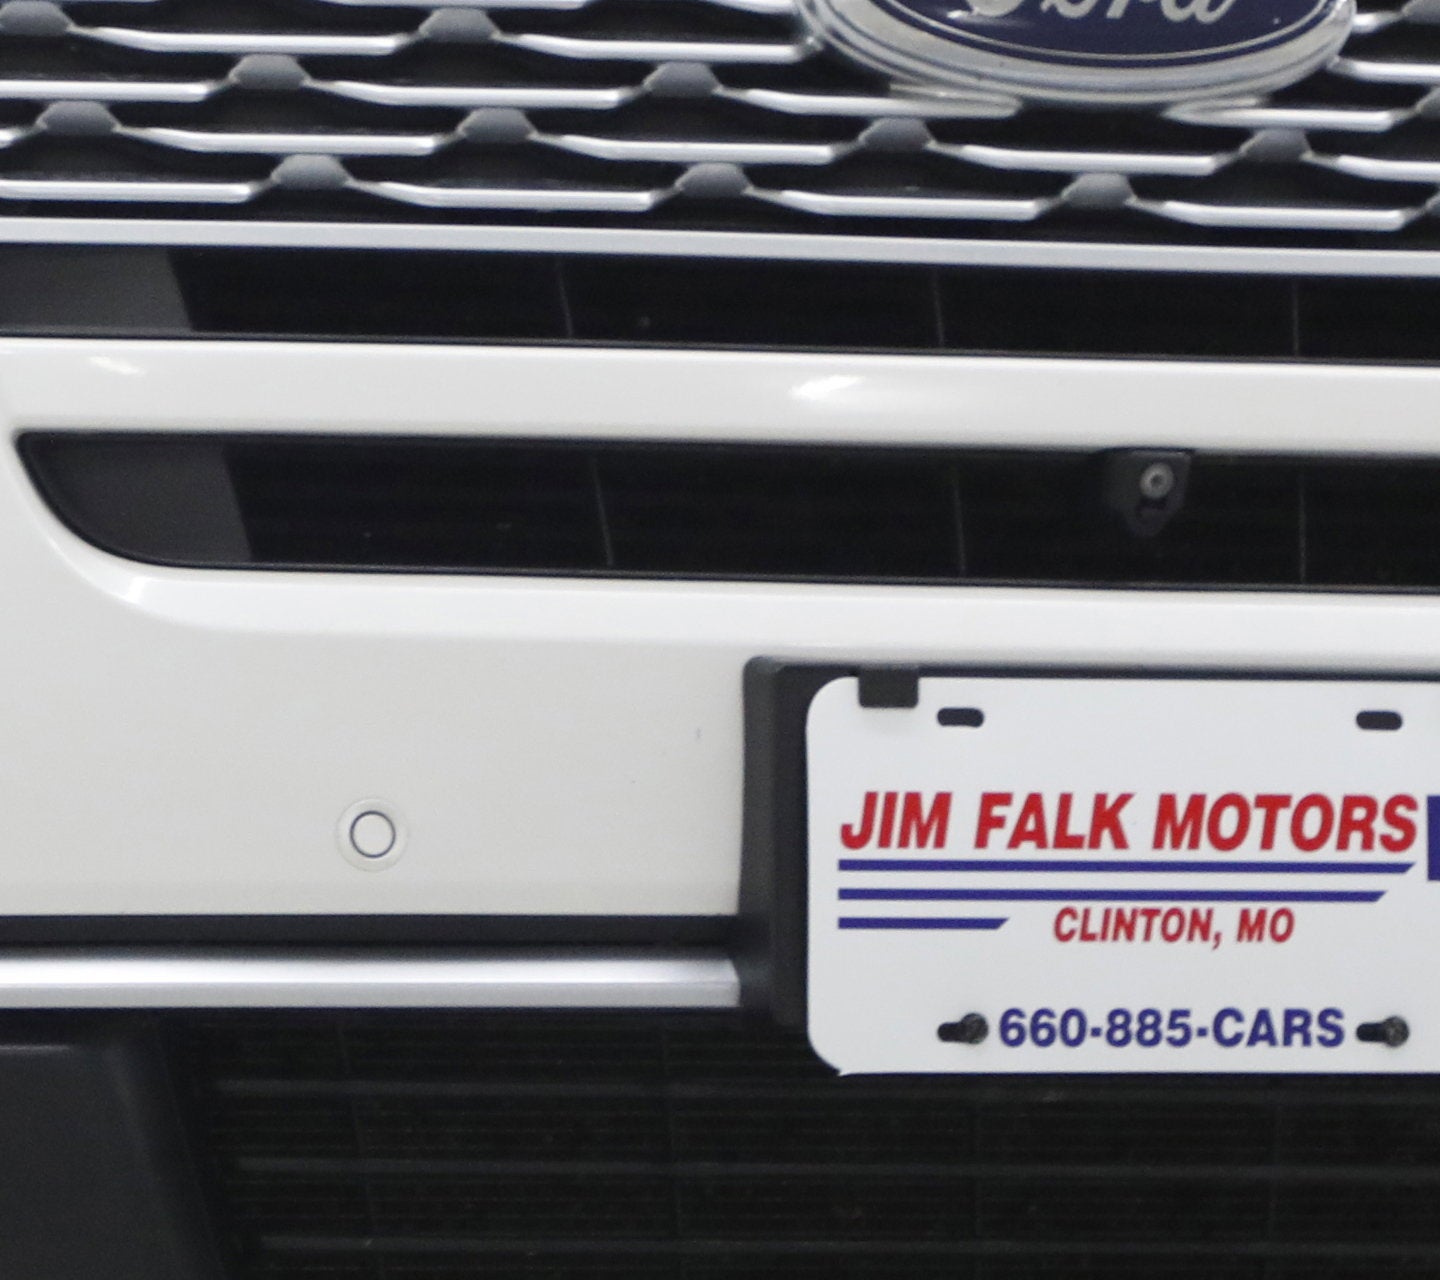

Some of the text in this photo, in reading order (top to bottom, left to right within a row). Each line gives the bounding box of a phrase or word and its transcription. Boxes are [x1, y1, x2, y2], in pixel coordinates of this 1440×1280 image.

[840, 791, 1419, 854] JIM FALK MOTORS
[1053, 906, 1296, 950] CLINTON, MO
[998, 1007, 1346, 1048] 660-885-CARS
